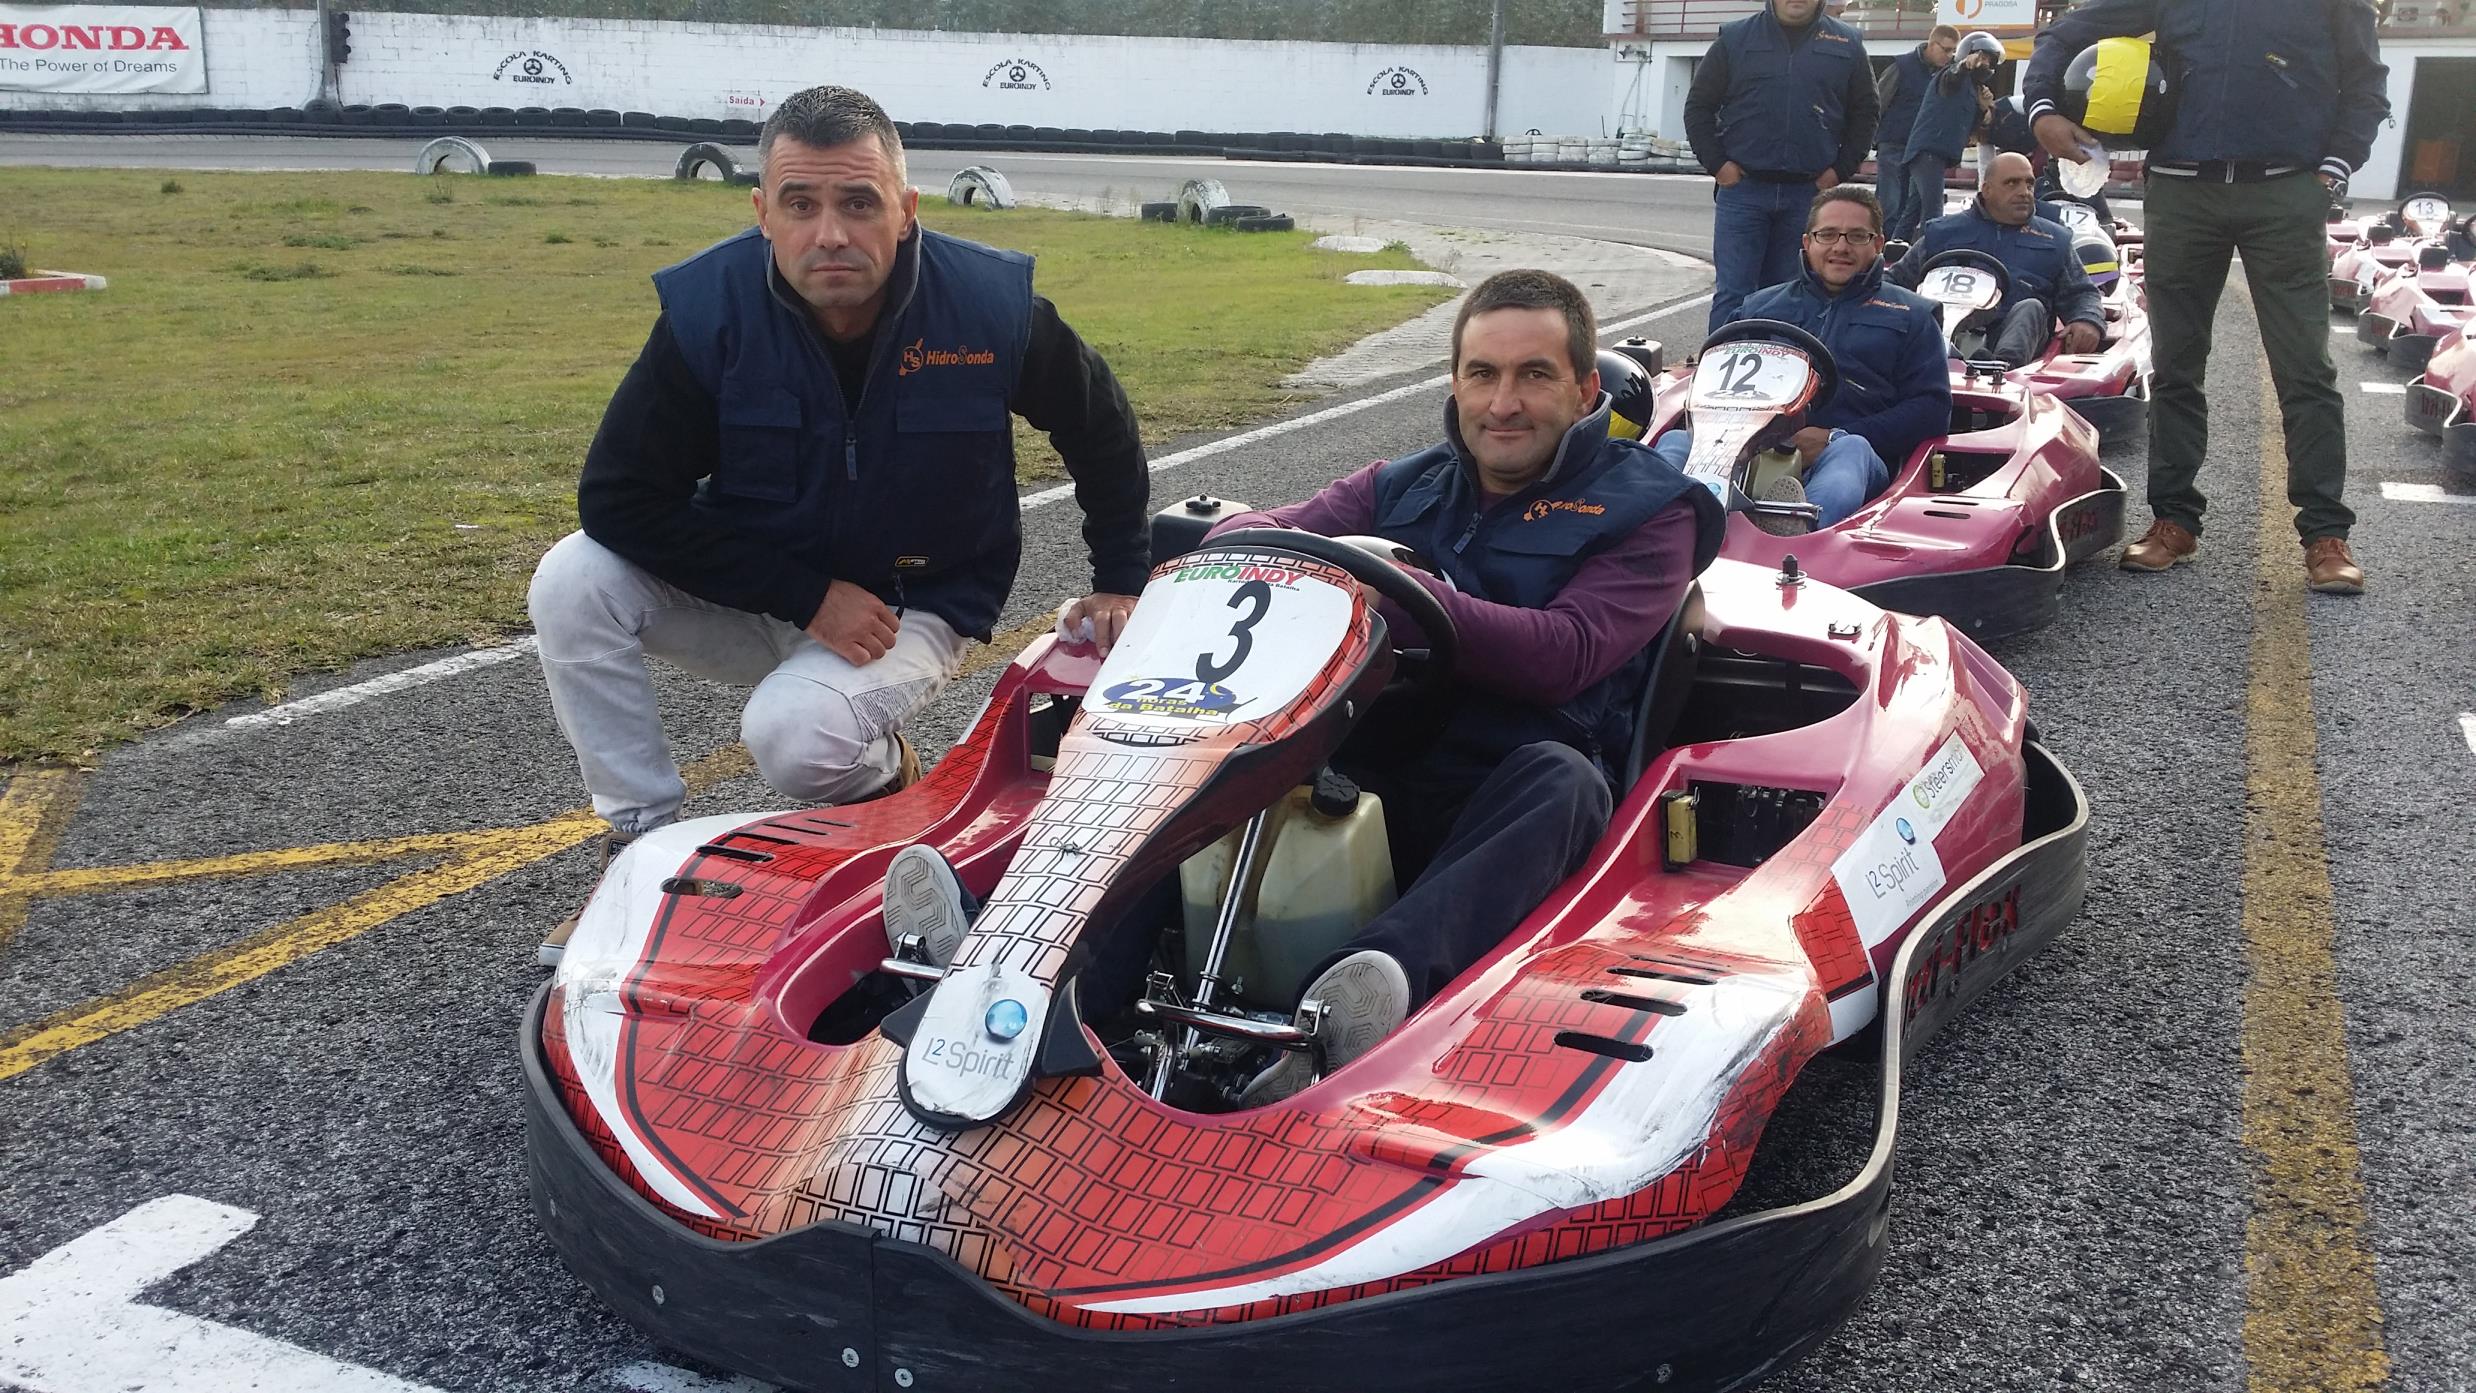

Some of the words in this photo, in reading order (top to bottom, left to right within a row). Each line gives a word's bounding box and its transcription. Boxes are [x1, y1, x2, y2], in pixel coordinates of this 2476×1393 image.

[0, 58, 29, 71] The
[35, 59, 89, 72] Power
[93, 60, 108, 72] of
[113, 60, 177, 73] Dreams
[493, 51, 527, 80] ESCOLA
[533, 50, 573, 85] KARTING
[982, 58, 1012, 88] ESCOLA
[1017, 58, 1051, 91] KARTING
[513, 75, 555, 84] EUROINDY
[1000, 82, 1037, 90] EUROINDY
[1367, 67, 1394, 95] ESCOLA
[1398, 66, 1429, 95] KARTING
[2066, 210, 2089, 224] 17
[1941, 272, 1976, 294] 18
[926, 345, 994, 366] HidroSonda
[1719, 353, 1763, 393] 12
[1174, 565, 1305, 586] EUROINDY
[1195, 579, 1272, 684] 3
[1119, 679, 1207, 703] 24
[1108, 701, 1133, 710] da
[1139, 703, 1218, 716] Batalha
